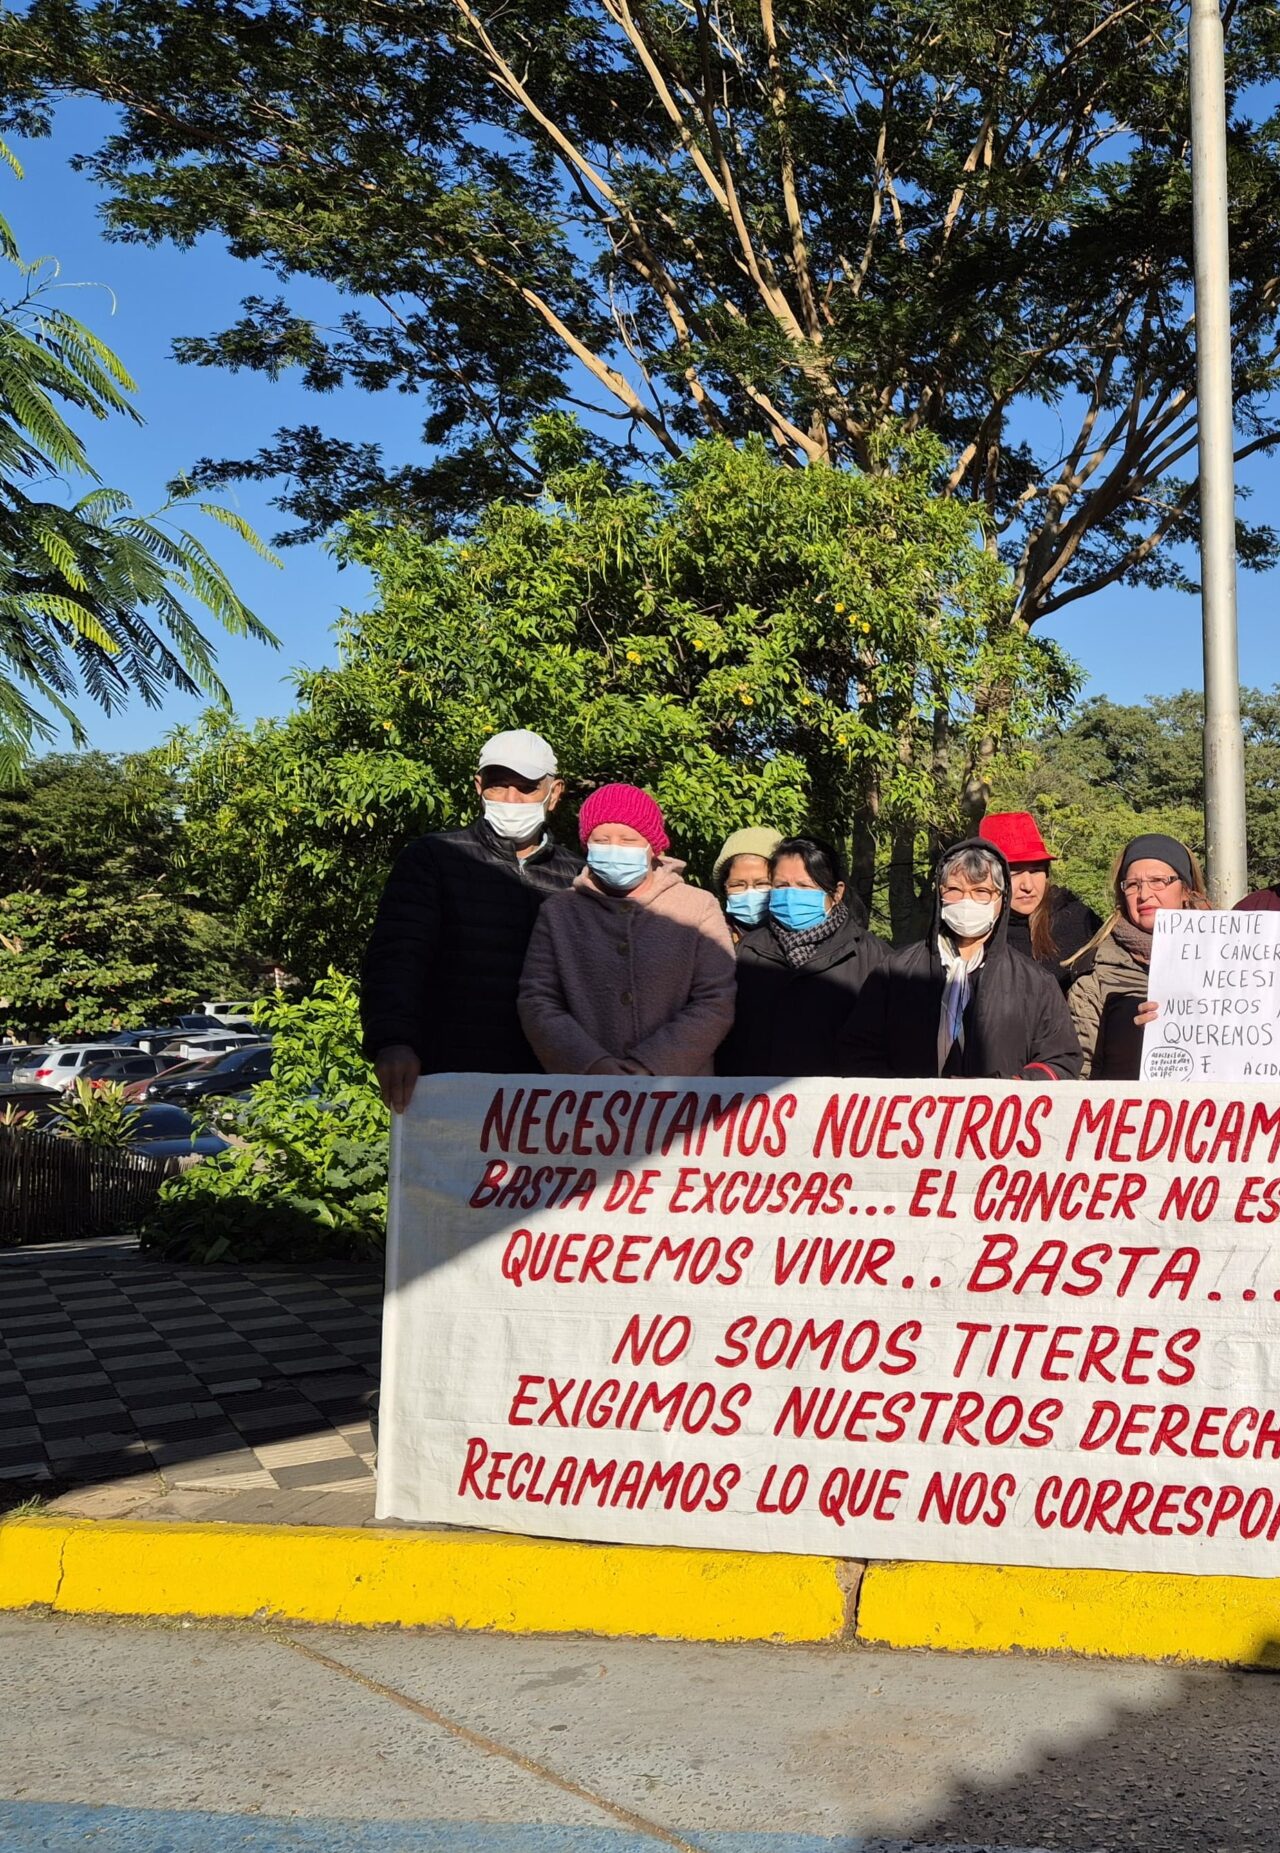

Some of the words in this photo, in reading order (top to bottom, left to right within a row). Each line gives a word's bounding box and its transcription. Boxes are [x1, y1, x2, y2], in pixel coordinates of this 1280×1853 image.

[1181, 944, 1202, 961] EL
[1163, 998, 1262, 1017] NUESTROS
[1163, 1022, 1274, 1047] QUEREMOS
[480, 1087, 798, 1158] NECESITAMOS
[812, 1093, 1053, 1161] NUESTROS
[468, 1159, 600, 1212] BASTA
[603, 1169, 662, 1215] DE
[909, 1168, 958, 1219] EL
[974, 1164, 1147, 1223] CANCER
[1159, 1176, 1220, 1223] NO
[501, 1229, 754, 1288] QUEREMOS
[612, 1314, 692, 1367] NO
[715, 1315, 923, 1376] SOMOS
[953, 1321, 1201, 1387] TITERES
[508, 1374, 752, 1437] EXIGIMOS
[773, 1386, 1064, 1449] NUESTROS
[458, 1437, 742, 1513] RECLAMAMOS
[756, 1464, 809, 1515] LO
[818, 1467, 910, 1527] QUE
[917, 1472, 1017, 1528] NOS
